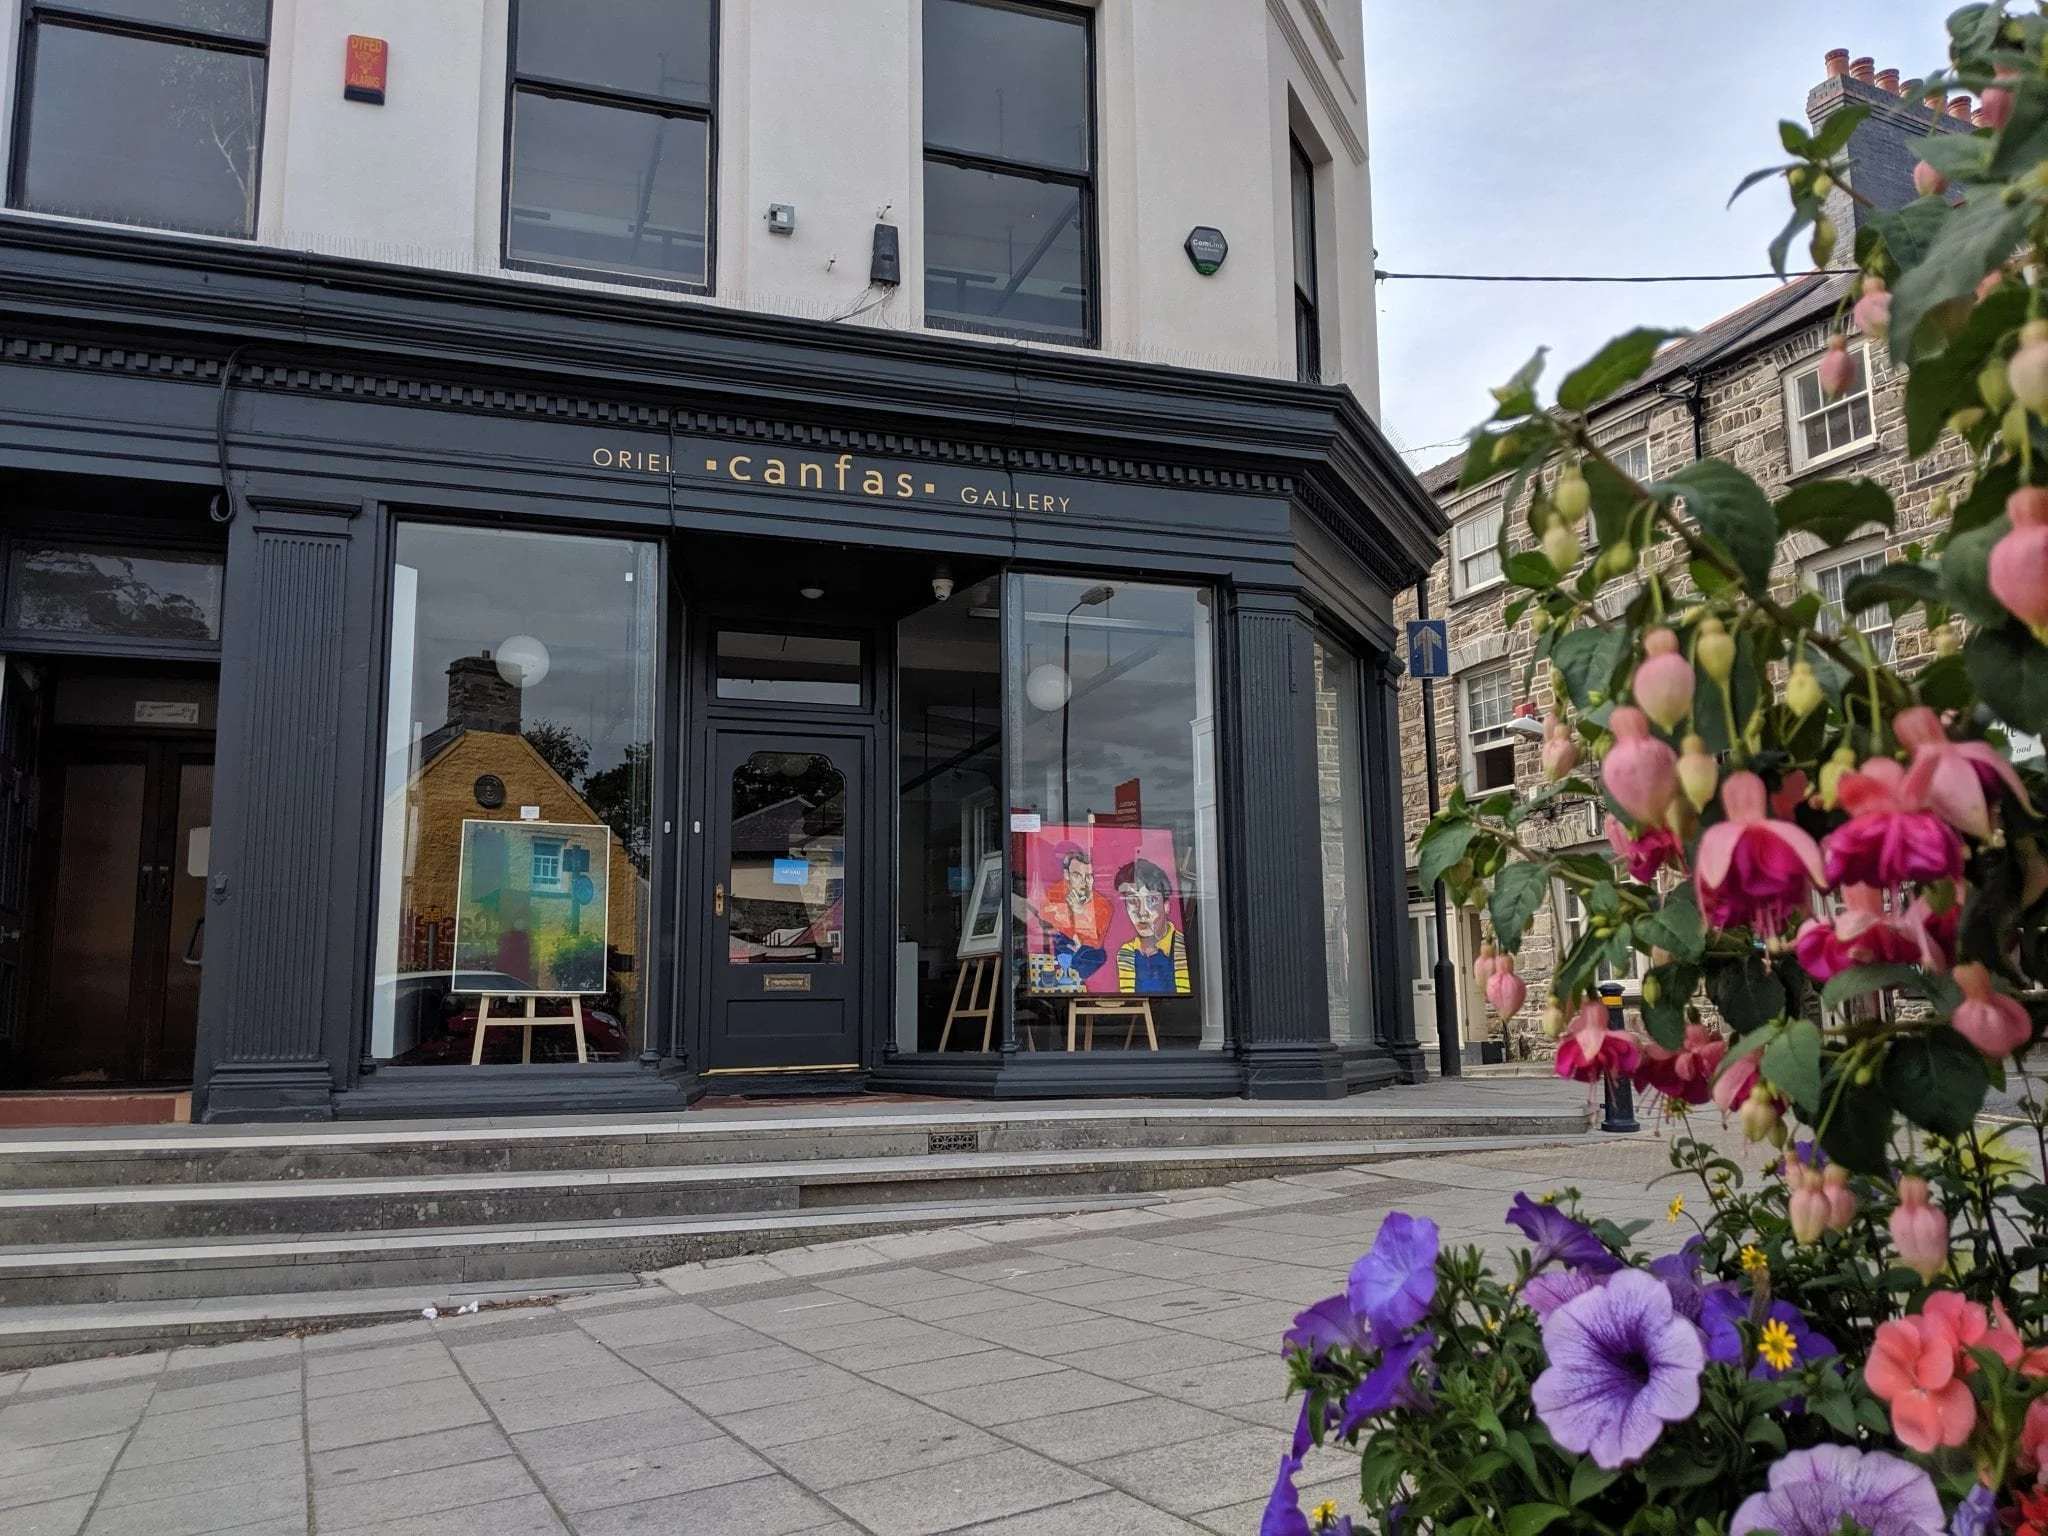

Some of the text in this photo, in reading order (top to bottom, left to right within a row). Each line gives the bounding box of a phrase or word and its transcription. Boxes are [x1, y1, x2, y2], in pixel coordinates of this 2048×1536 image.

[593, 448, 1070, 513] ORIEL canfas GALLERY
